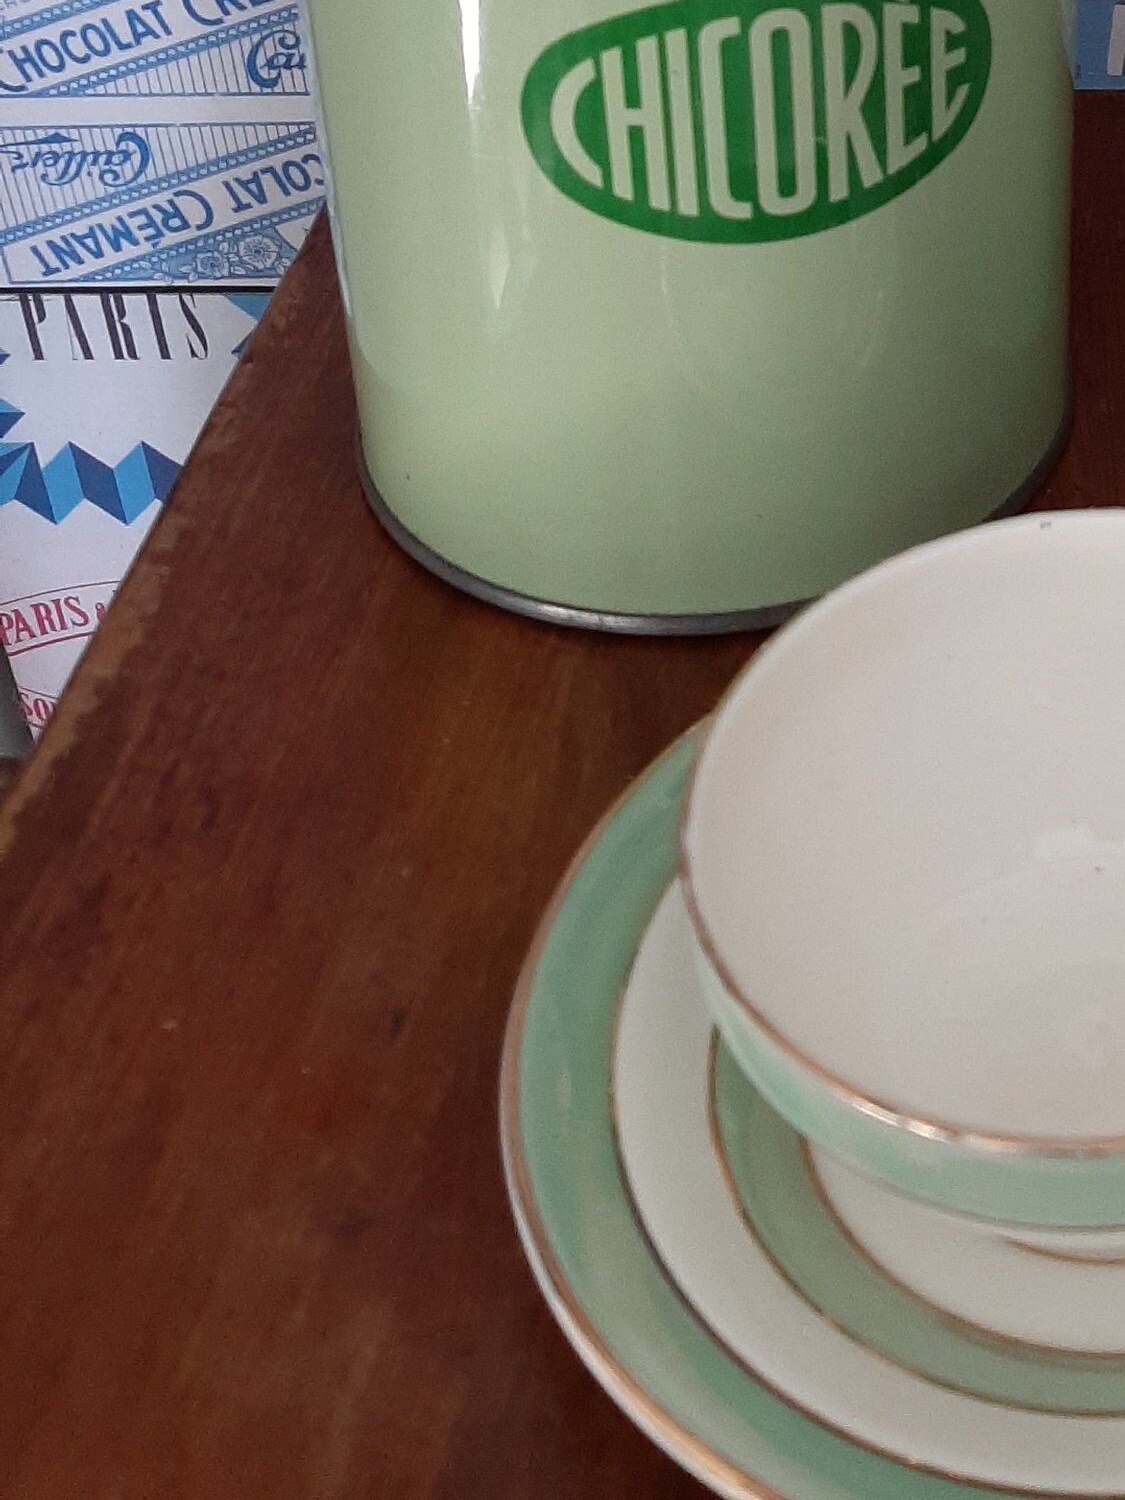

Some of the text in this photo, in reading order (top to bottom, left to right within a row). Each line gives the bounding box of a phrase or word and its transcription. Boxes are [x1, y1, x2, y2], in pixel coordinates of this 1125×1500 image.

[29, 188, 215, 278] CRÉMANT
[18, 292, 209, 362] PARIS
[0, 595, 90, 647] PARIS
